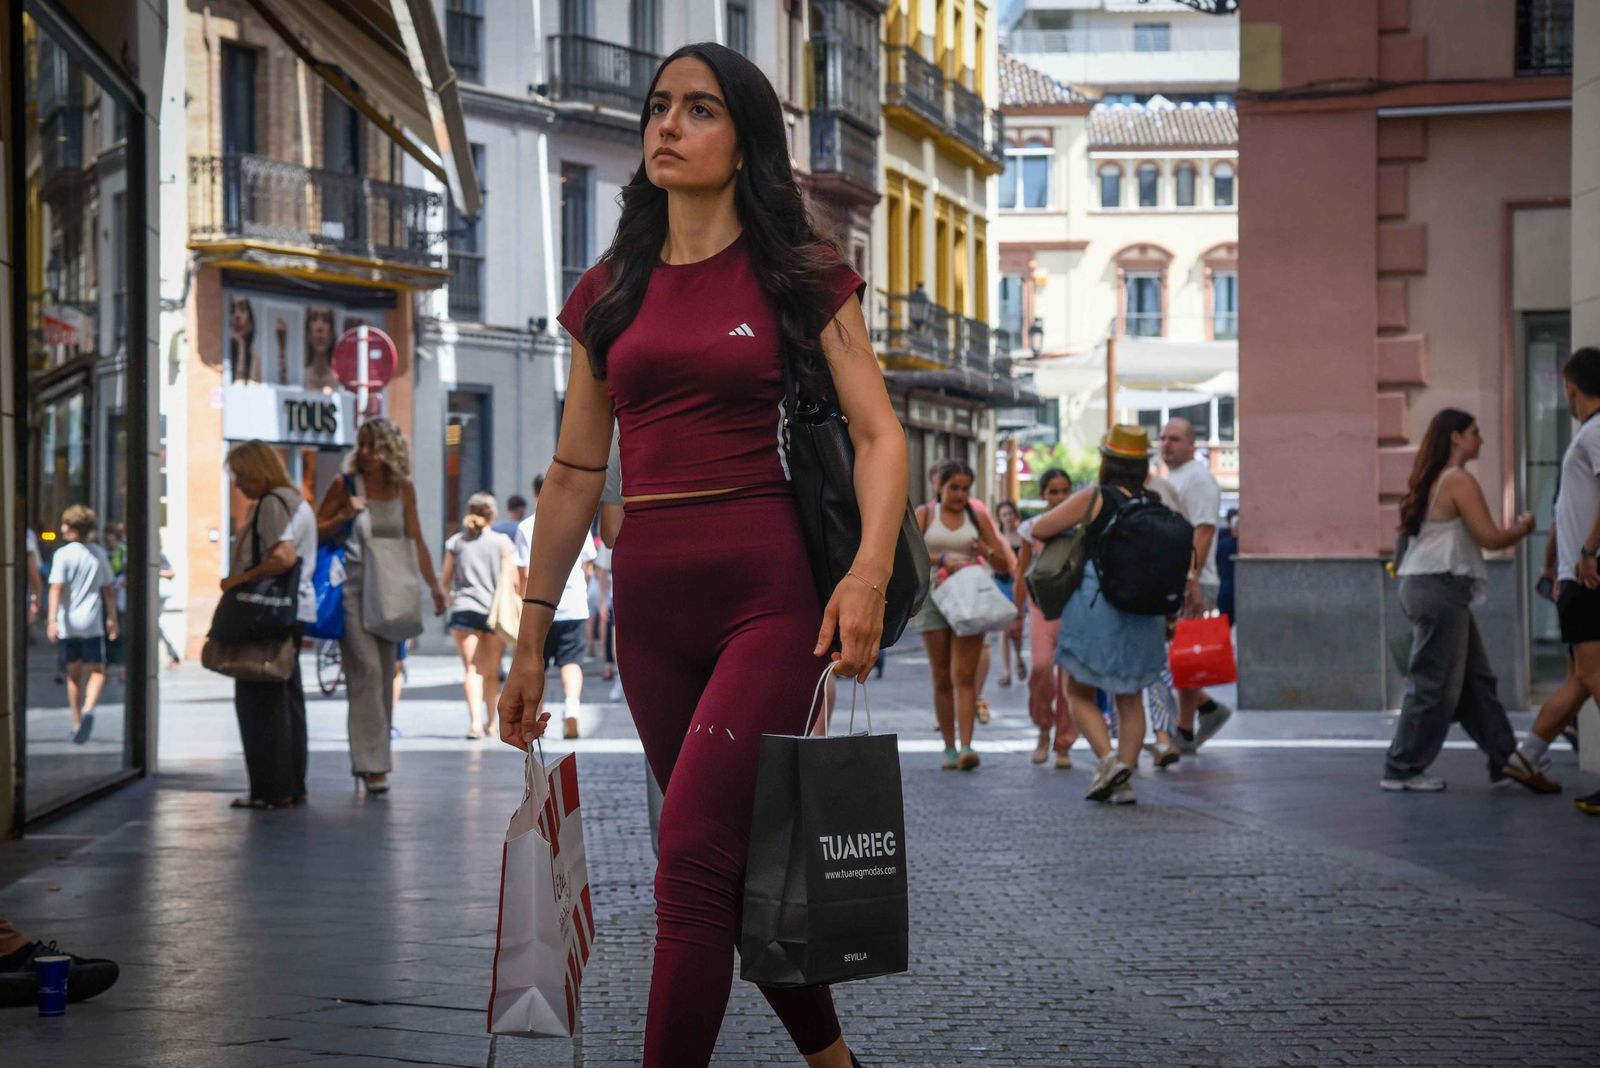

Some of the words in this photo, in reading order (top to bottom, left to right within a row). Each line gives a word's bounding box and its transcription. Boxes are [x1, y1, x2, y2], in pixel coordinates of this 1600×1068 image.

[284, 399, 337, 433] TOUS
[819, 831, 897, 861] TUAREG
[824, 865, 897, 880] www.tuaregmodas.com
[843, 952, 868, 962] SEVILLA
